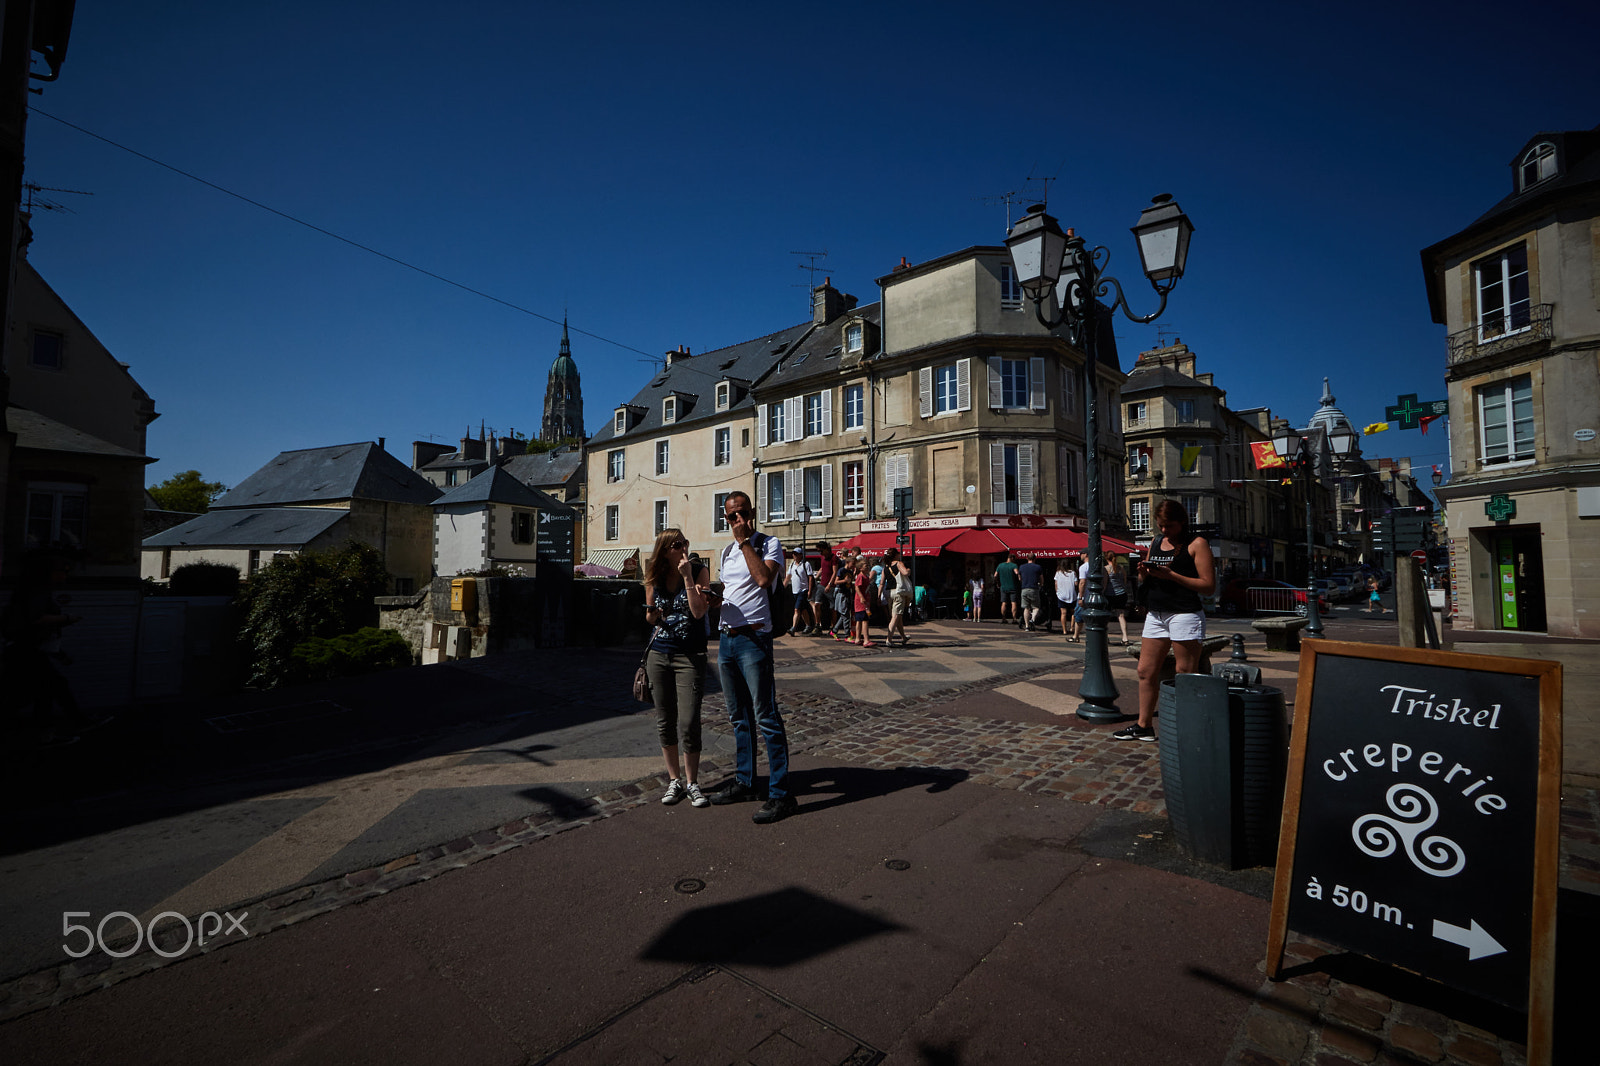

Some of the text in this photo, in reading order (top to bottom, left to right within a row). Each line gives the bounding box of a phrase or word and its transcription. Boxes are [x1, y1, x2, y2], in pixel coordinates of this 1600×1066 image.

[1379, 684, 1501, 730] Triskel
[1322, 742, 1508, 816] creperie
[1305, 876, 1323, 901] à
